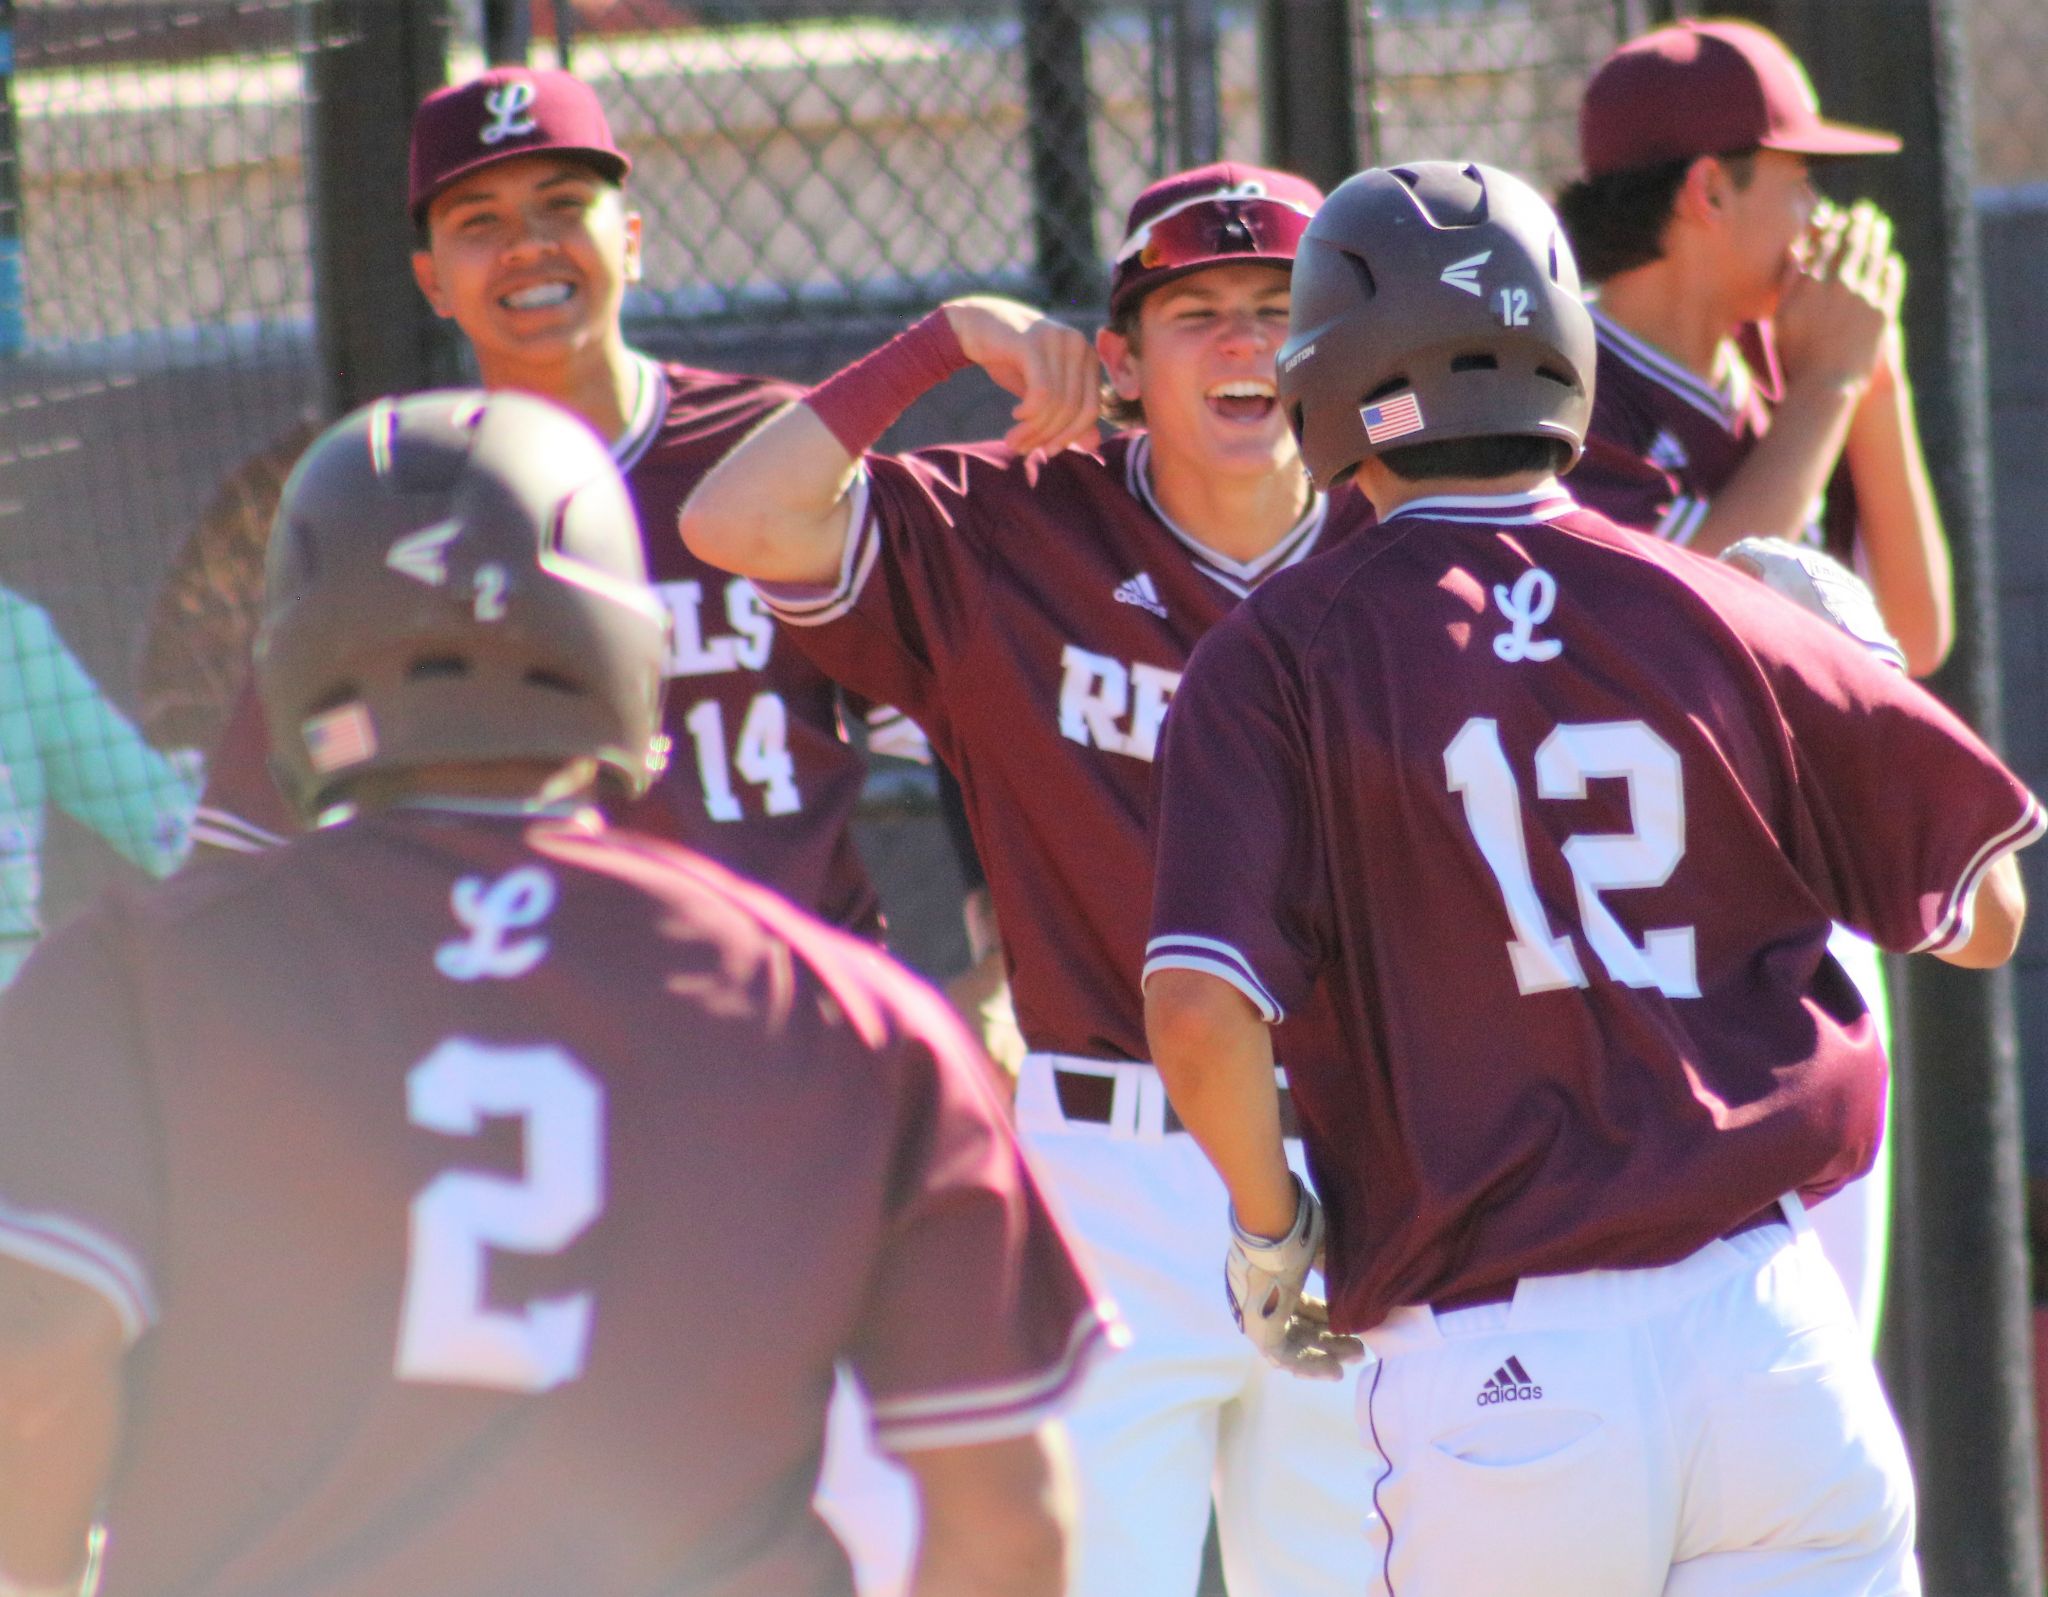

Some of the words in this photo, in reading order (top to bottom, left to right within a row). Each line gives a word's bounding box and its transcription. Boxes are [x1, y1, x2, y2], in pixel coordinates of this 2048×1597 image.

[1500, 288, 1529, 327] 12
[473, 563, 511, 621] 2
[1493, 567, 1562, 663] L
[685, 691, 800, 822] 14
[1442, 716, 1703, 999] 12
[433, 866, 557, 981] L
[393, 1036, 605, 1394] 2
[1476, 1383, 1543, 1407] adidas
